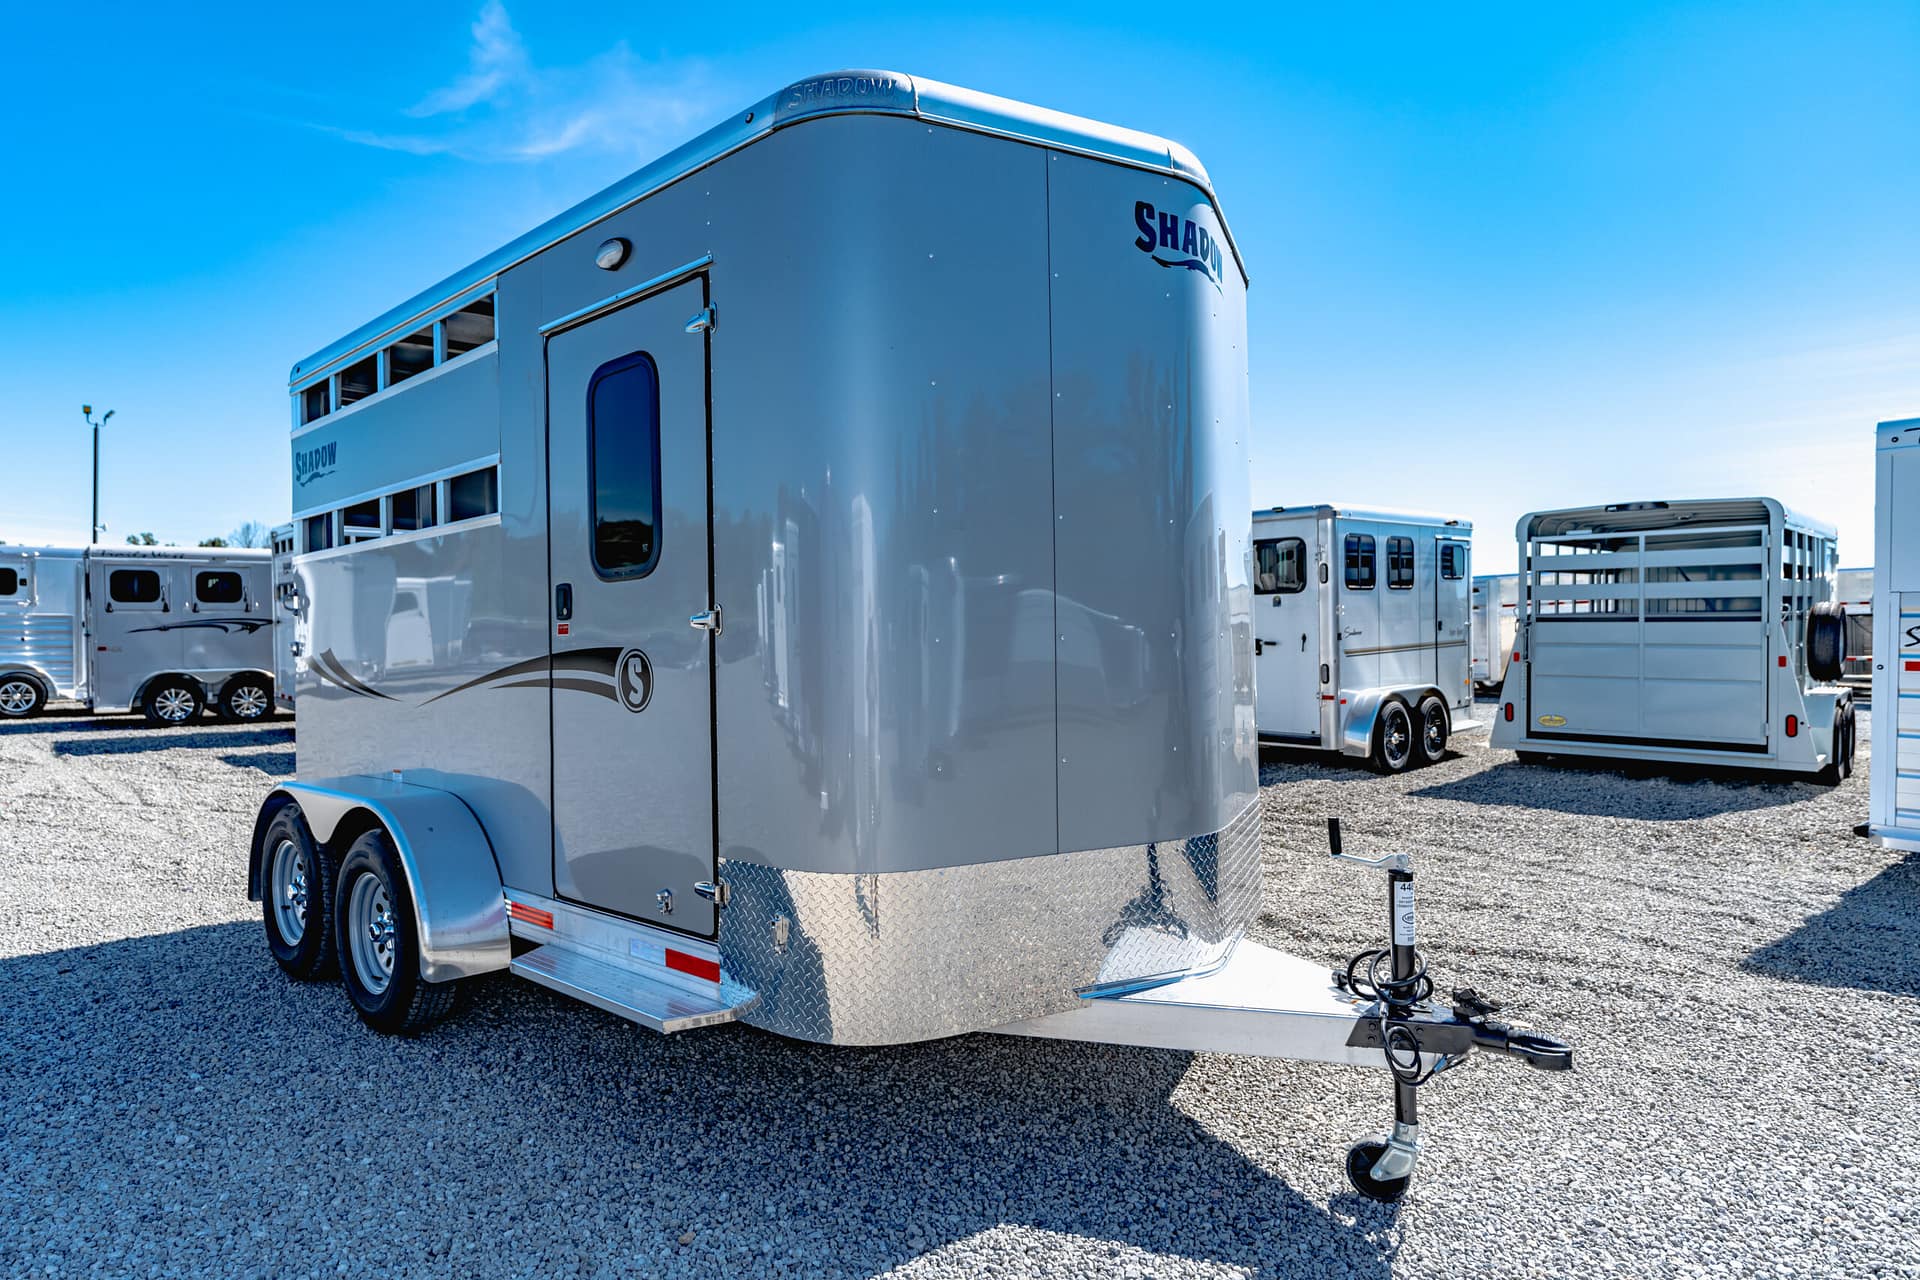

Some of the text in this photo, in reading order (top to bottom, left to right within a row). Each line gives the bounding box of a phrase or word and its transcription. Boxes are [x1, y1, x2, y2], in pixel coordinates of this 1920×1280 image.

[787, 76, 897, 109] SHADOW
[1134, 200, 1223, 284] SHADOW
[295, 441, 337, 482] SHADOW
